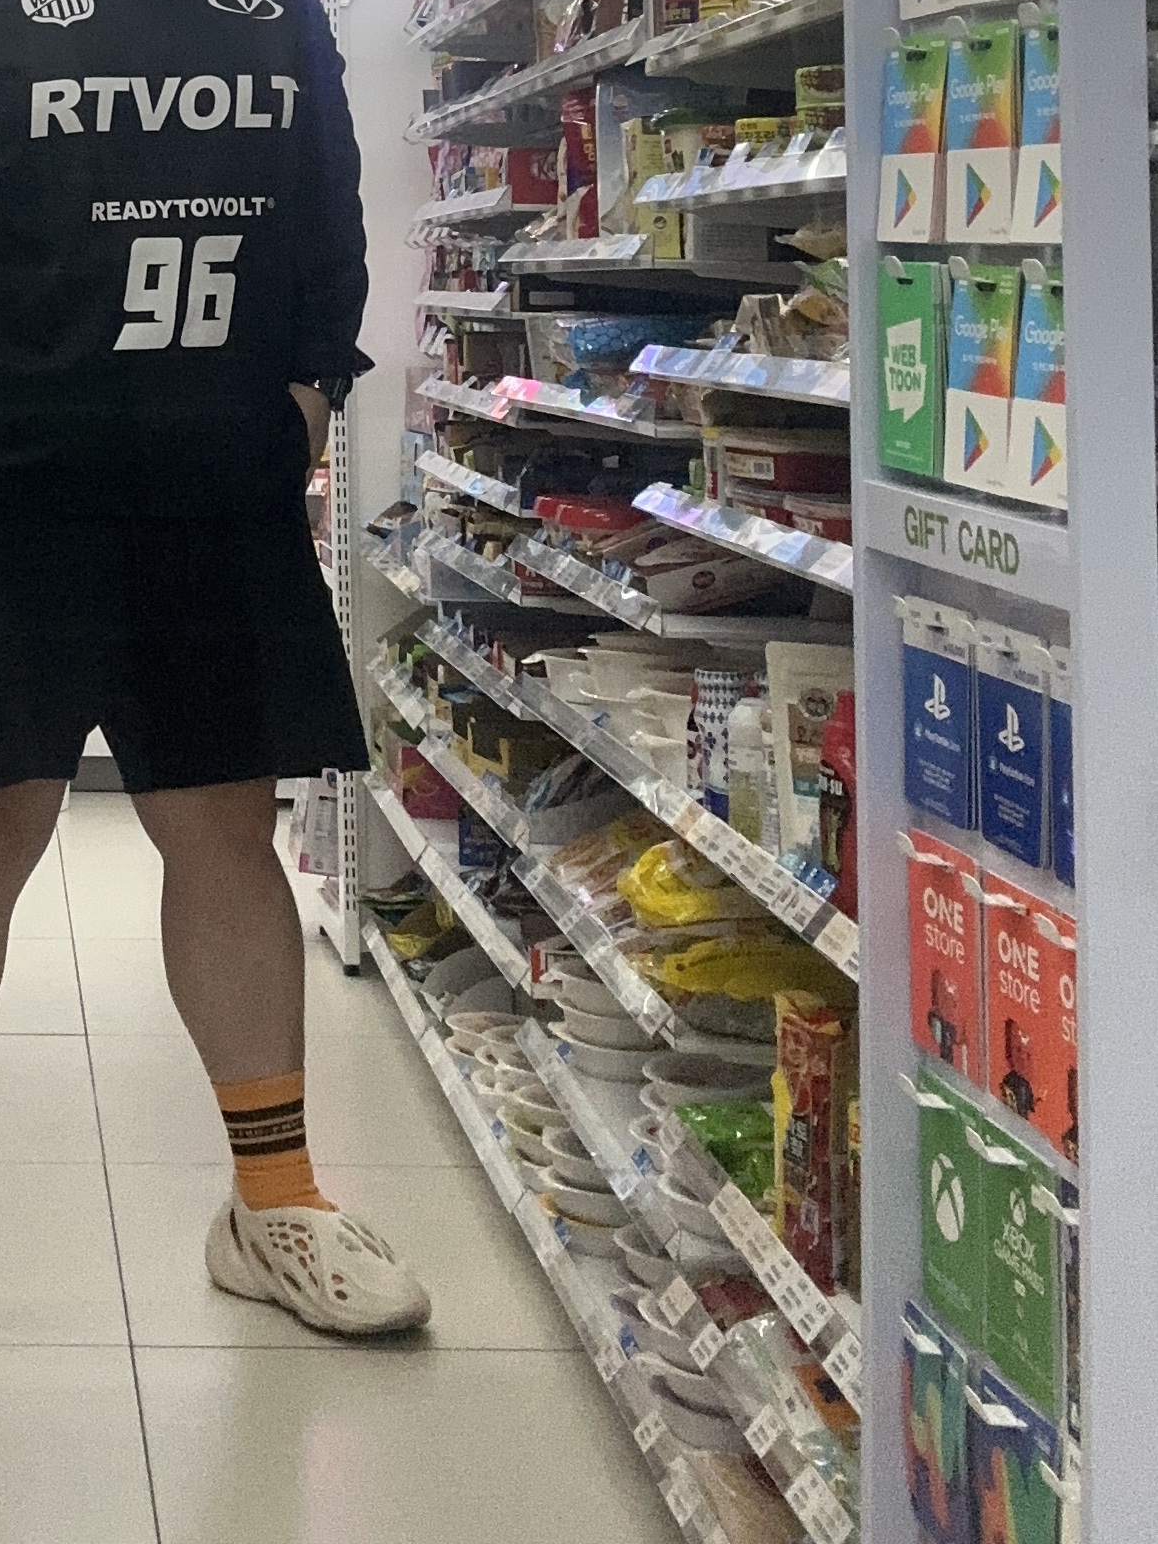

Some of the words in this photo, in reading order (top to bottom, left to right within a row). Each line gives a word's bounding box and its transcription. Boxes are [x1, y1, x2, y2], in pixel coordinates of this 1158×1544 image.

[30, 75, 300, 139] RTVOLT
[951, 76, 984, 103] Google
[113, 235, 243, 351] 96
[954, 315, 988, 344] Google
[888, 367, 922, 392] TOON
[893, 344, 917, 368] WEB
[904, 505, 949, 555] GIFT
[958, 519, 1020, 576] CARD
[922, 886, 965, 935] ONE
[924, 923, 966, 966] store
[997, 930, 1040, 982] ONE
[998, 967, 1041, 1014] store
